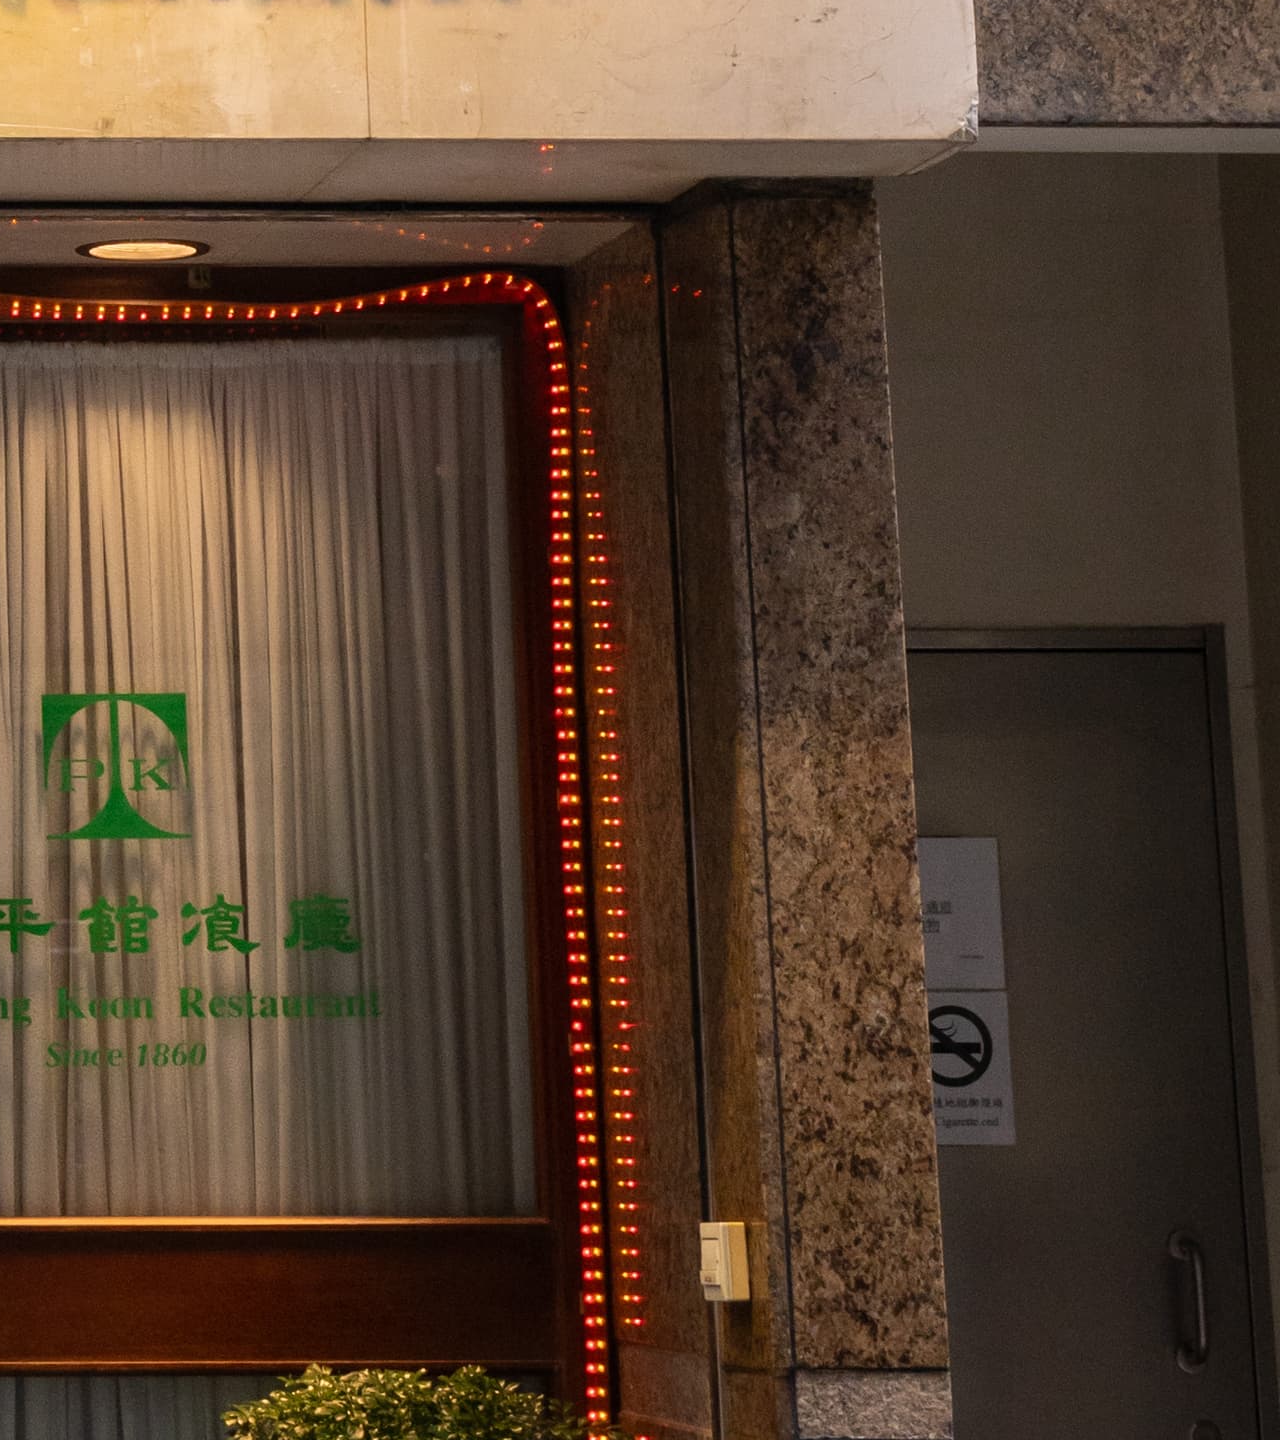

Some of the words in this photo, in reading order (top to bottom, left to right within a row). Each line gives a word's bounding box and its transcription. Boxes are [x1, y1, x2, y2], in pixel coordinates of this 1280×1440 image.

[56, 986, 154, 1022] Koon
[178, 986, 383, 1022] Restaurant
[45, 1041, 124, 1068] Since
[135, 1041, 207, 1068] 1860
